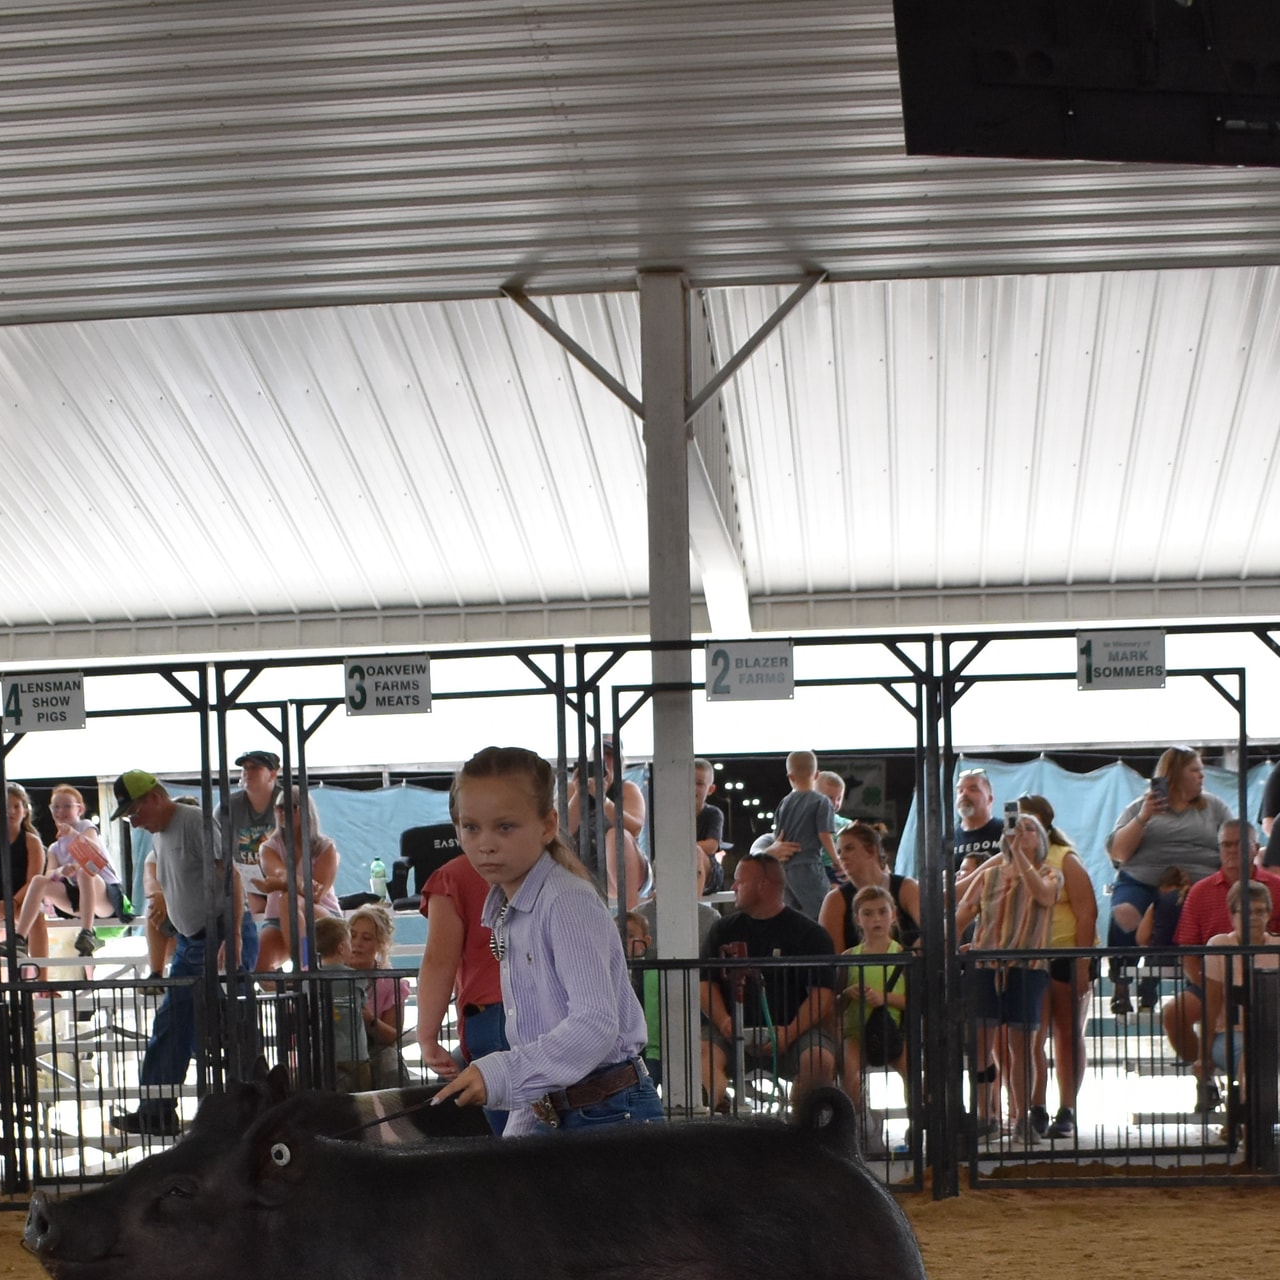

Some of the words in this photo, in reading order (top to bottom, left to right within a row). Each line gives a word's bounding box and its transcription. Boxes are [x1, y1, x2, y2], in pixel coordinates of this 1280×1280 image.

[735, 656, 788, 668] BLAZER
[1080, 639, 1093, 684] 1
[1108, 650, 1149, 662] MARK
[366, 664, 427, 676] OAKVEIW
[711, 649, 730, 695] 2
[1093, 666, 1163, 678] SOMMERS
[739, 672, 785, 684] FARMS
[20, 680, 81, 694] LENSMAN
[348, 665, 367, 710] 3
[375, 680, 419, 691] FARMS
[5, 683, 23, 726] 4
[32, 696, 70, 708] SHOW
[376, 695, 420, 707] MEATS
[37, 711, 67, 723] PIGS
